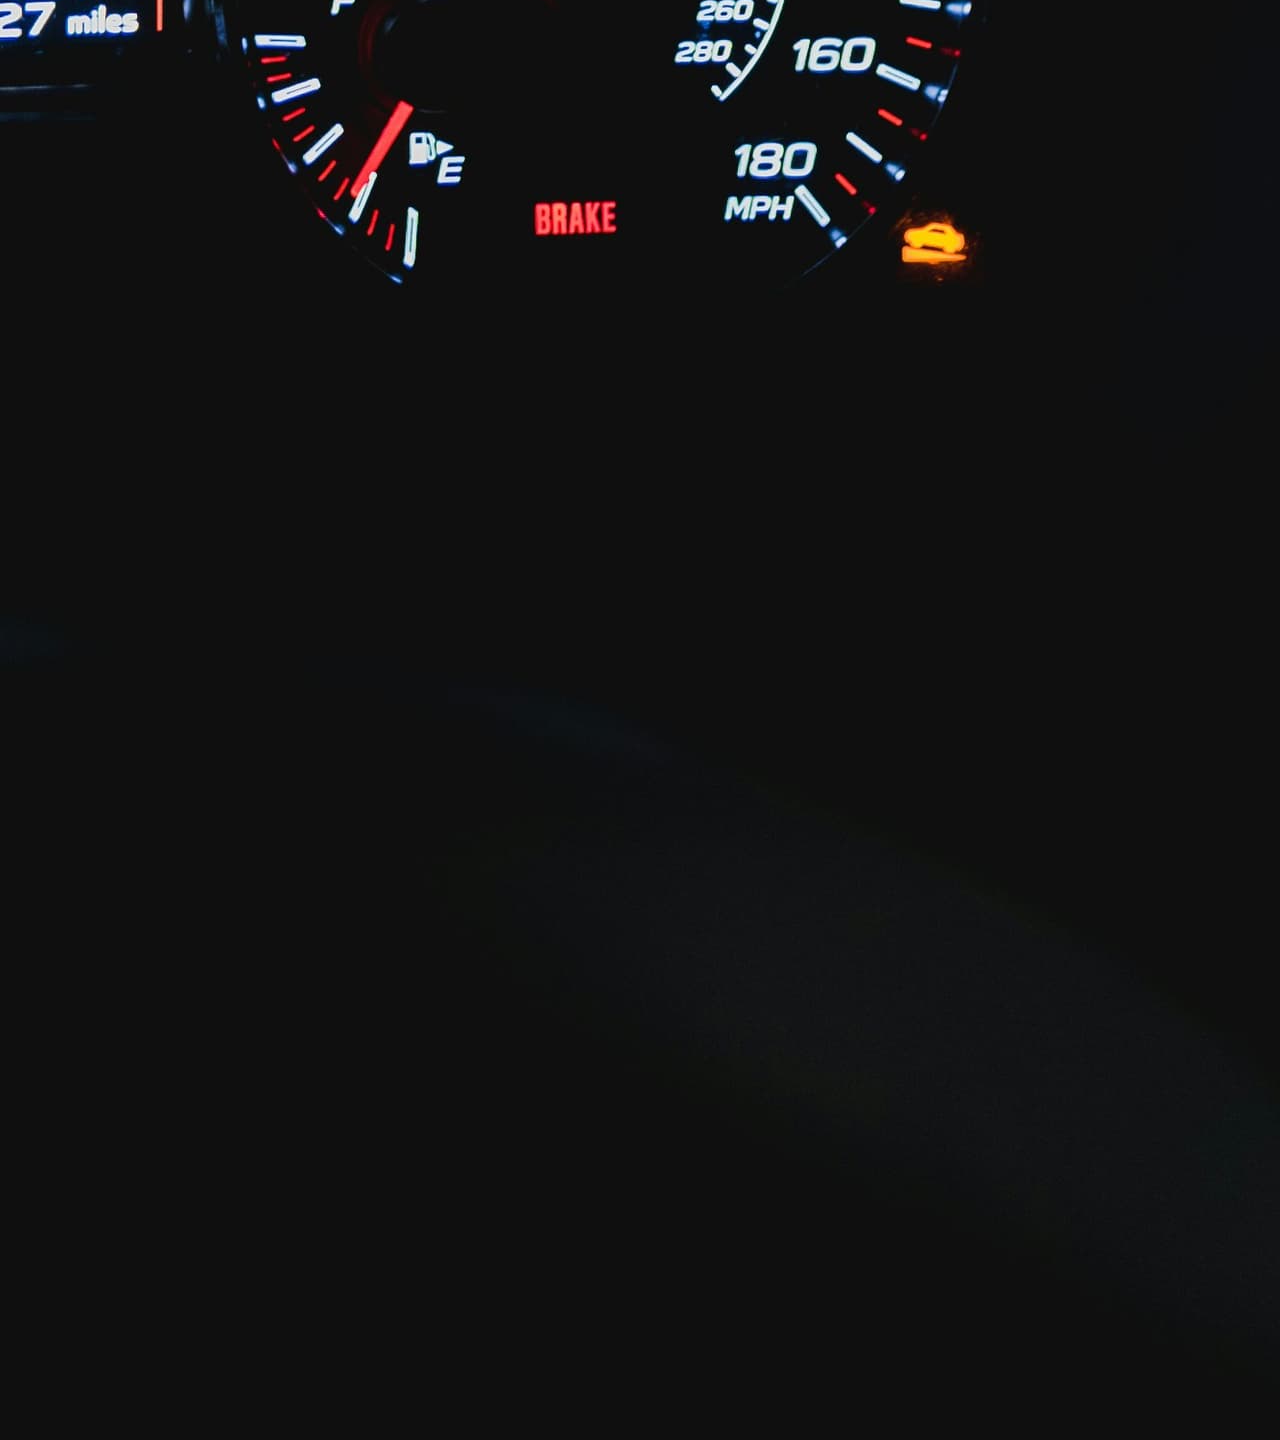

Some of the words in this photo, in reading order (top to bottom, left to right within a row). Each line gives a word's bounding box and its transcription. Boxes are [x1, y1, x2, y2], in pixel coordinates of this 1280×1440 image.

[67, 6, 139, 35] miles
[696, 0, 755, 22] 260
[675, 40, 731, 63] 280
[793, 37, 877, 72] 160
[436, 156, 464, 183] E
[735, 142, 817, 177] 180
[535, 201, 616, 235] BRAKE
[725, 196, 794, 220] MPH
